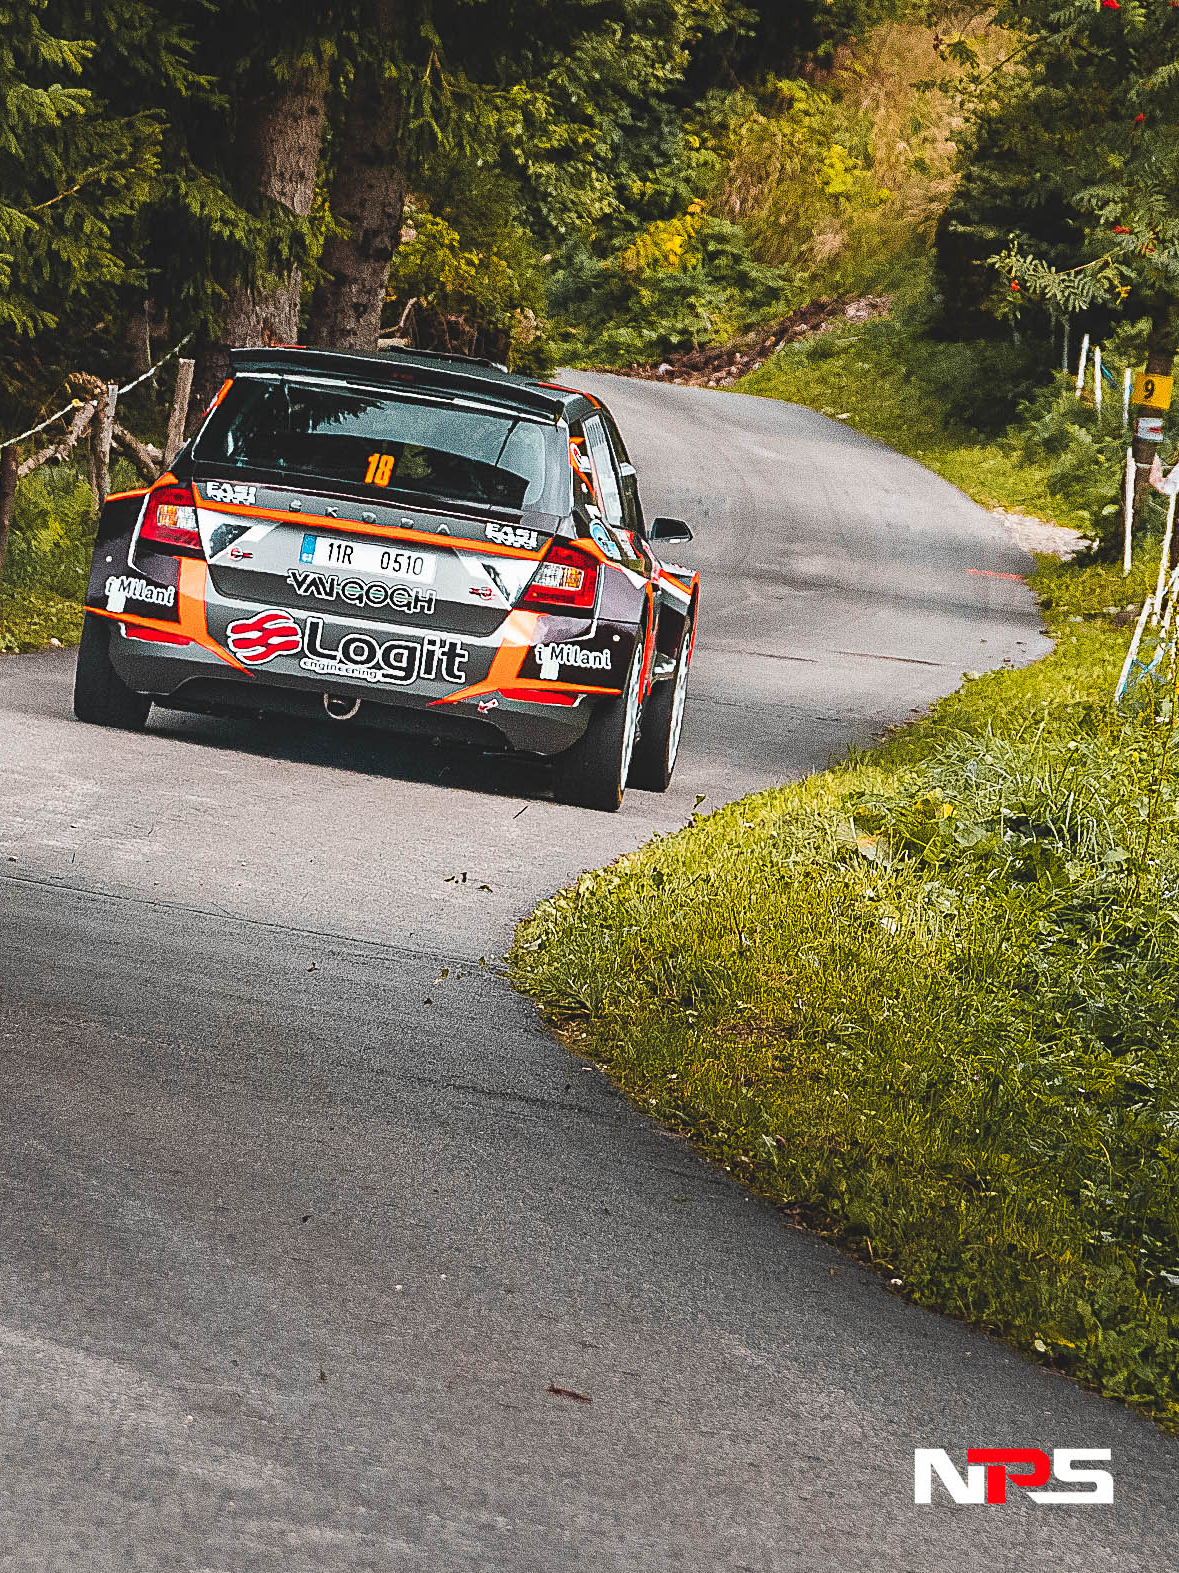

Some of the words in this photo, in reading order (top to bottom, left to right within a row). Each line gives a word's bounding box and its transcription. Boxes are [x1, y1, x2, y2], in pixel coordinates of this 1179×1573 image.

[1142, 379, 1155, 400] 9
[365, 453, 395, 488] 18
[328, 542, 354, 565] 11R
[380, 551, 424, 576] 0510
[119, 577, 175, 605] Milani
[305, 617, 468, 685] Logit
[550, 645, 610, 667] Milani
[303, 660, 378, 680] engineering
